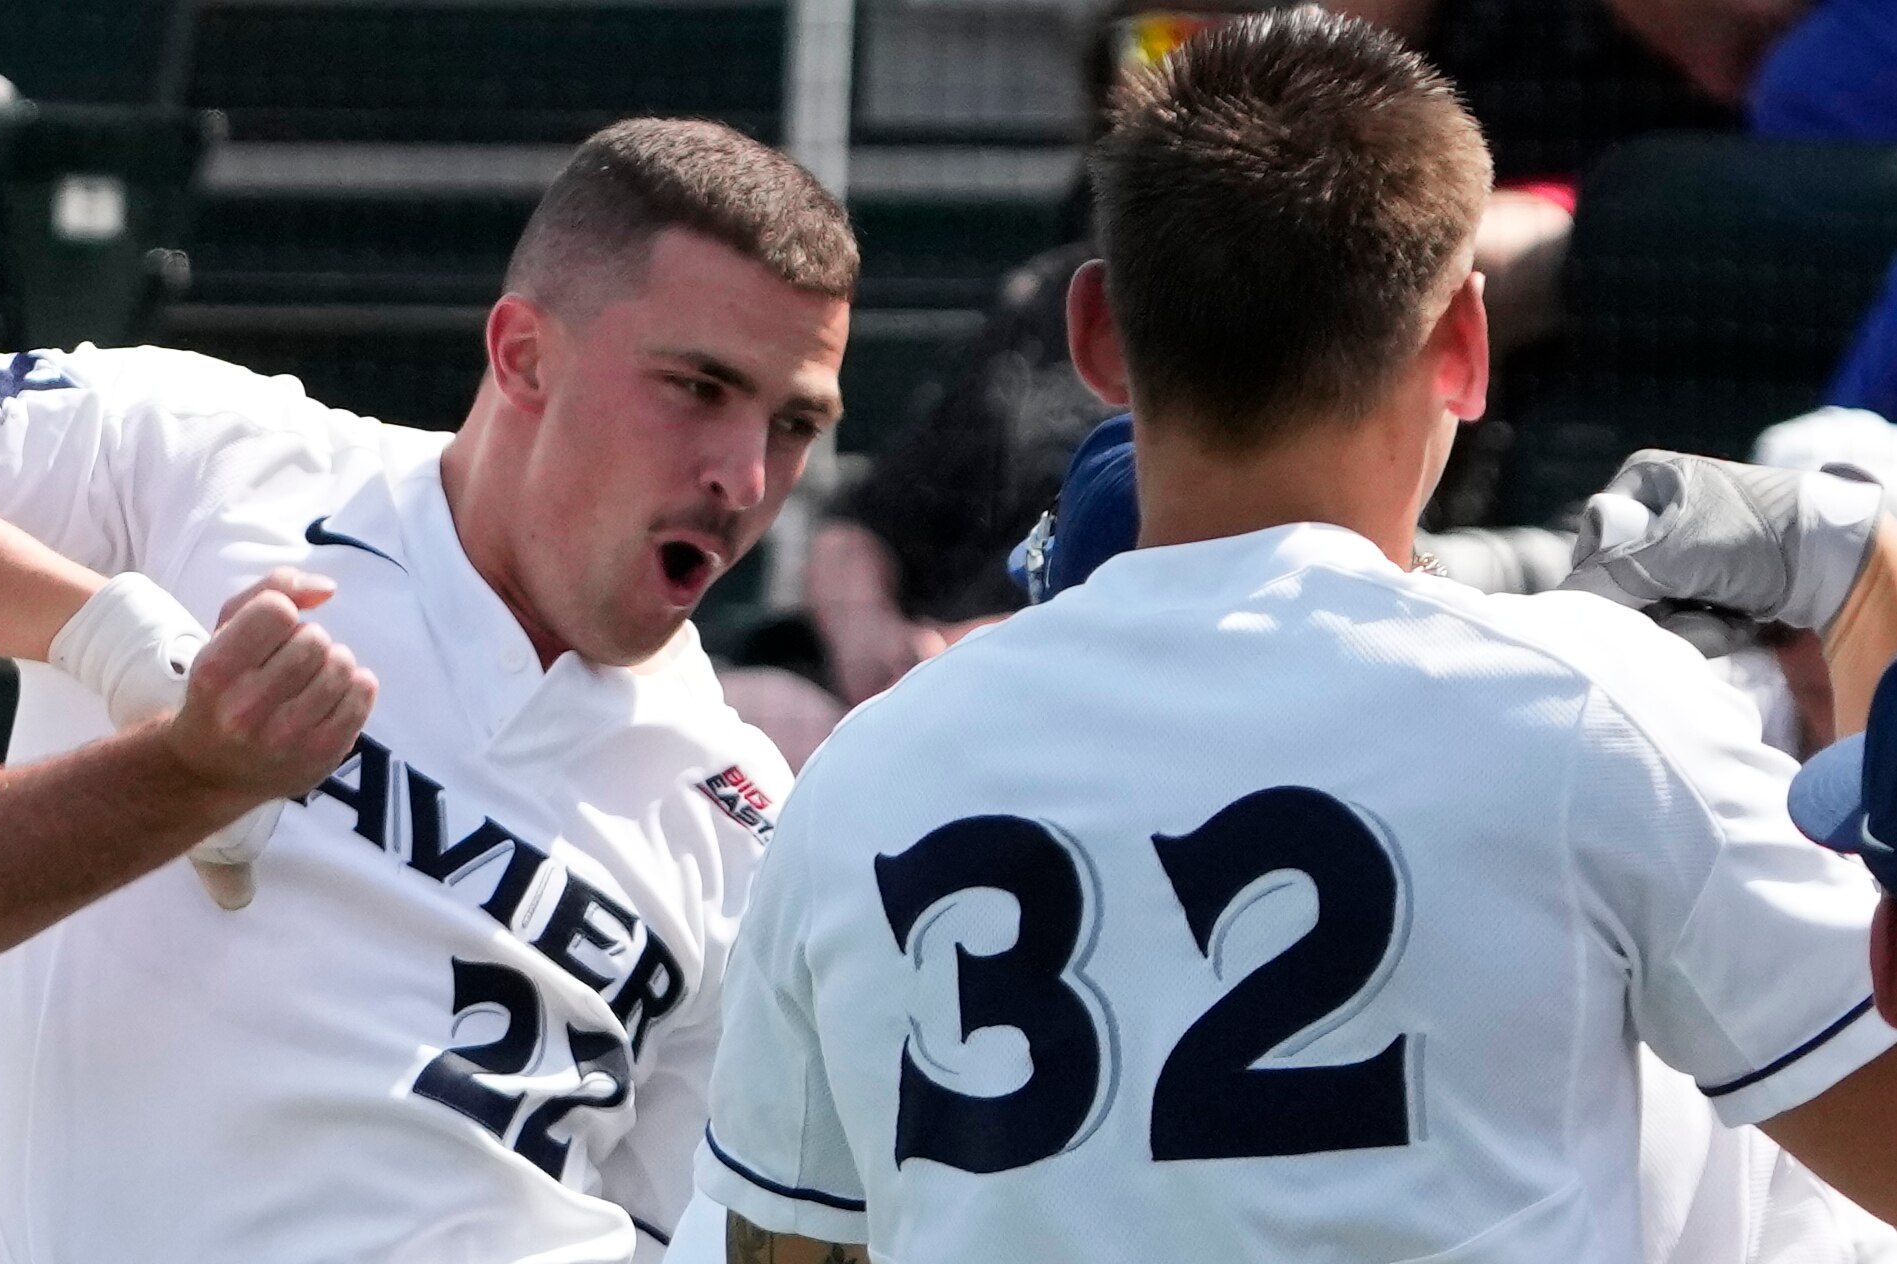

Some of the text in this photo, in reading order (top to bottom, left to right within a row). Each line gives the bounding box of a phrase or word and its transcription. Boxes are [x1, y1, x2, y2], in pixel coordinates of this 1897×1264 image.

[286, 732, 686, 1062] AVIER
[705, 775, 774, 834] EAST
[722, 766, 772, 810] BIG
[413, 956, 631, 1184] 22
[874, 785, 1419, 1175] 32
